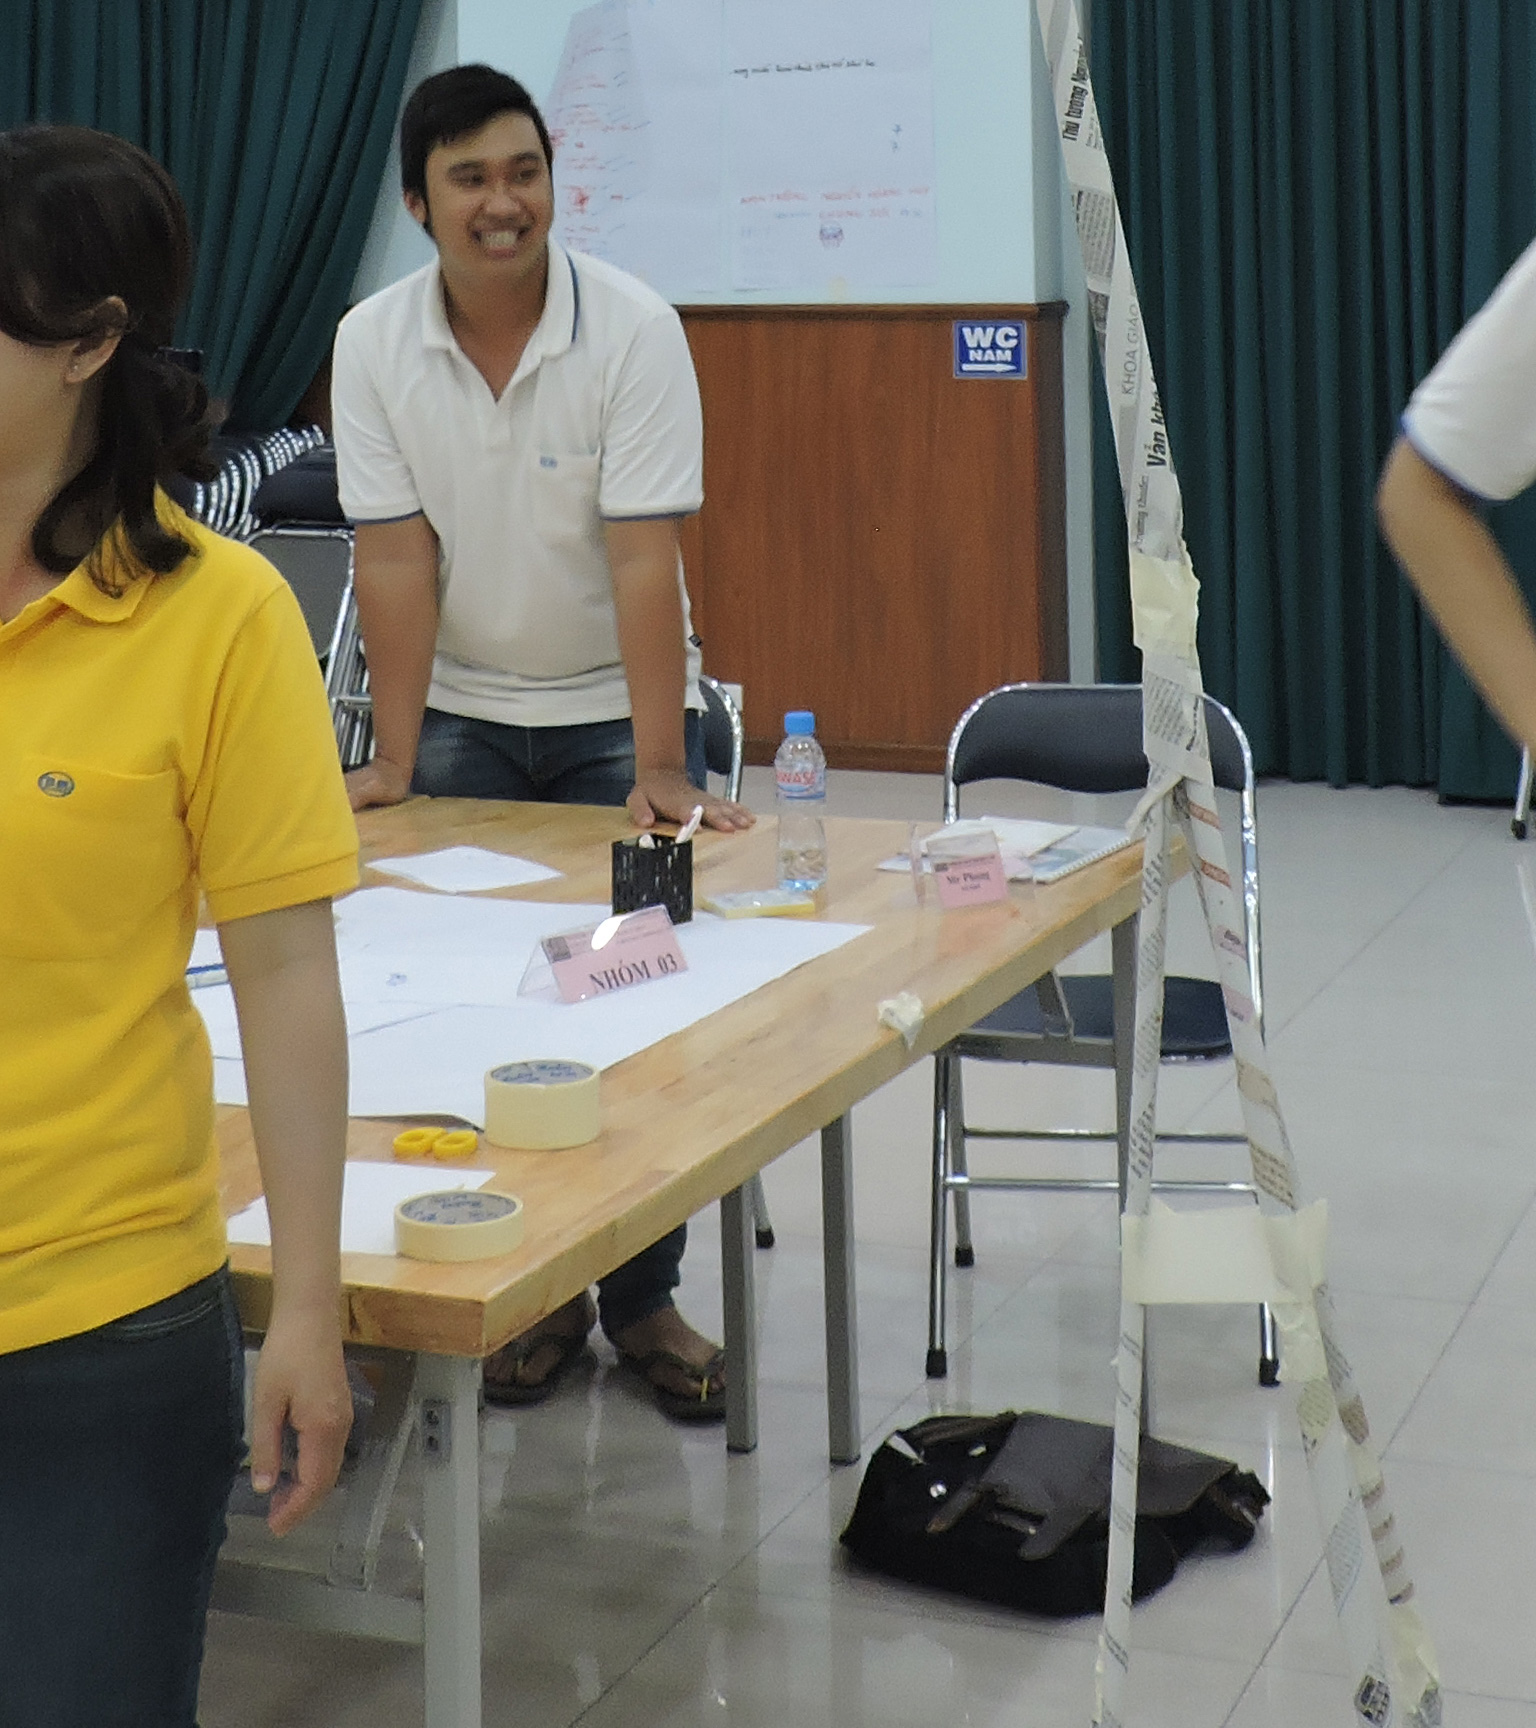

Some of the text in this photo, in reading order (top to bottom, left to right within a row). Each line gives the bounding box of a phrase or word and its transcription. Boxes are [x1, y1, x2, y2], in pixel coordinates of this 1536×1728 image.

[962, 327, 1018, 348] WC
[969, 349, 1012, 361] NAM
[589, 953, 679, 994] NHÓM 03
